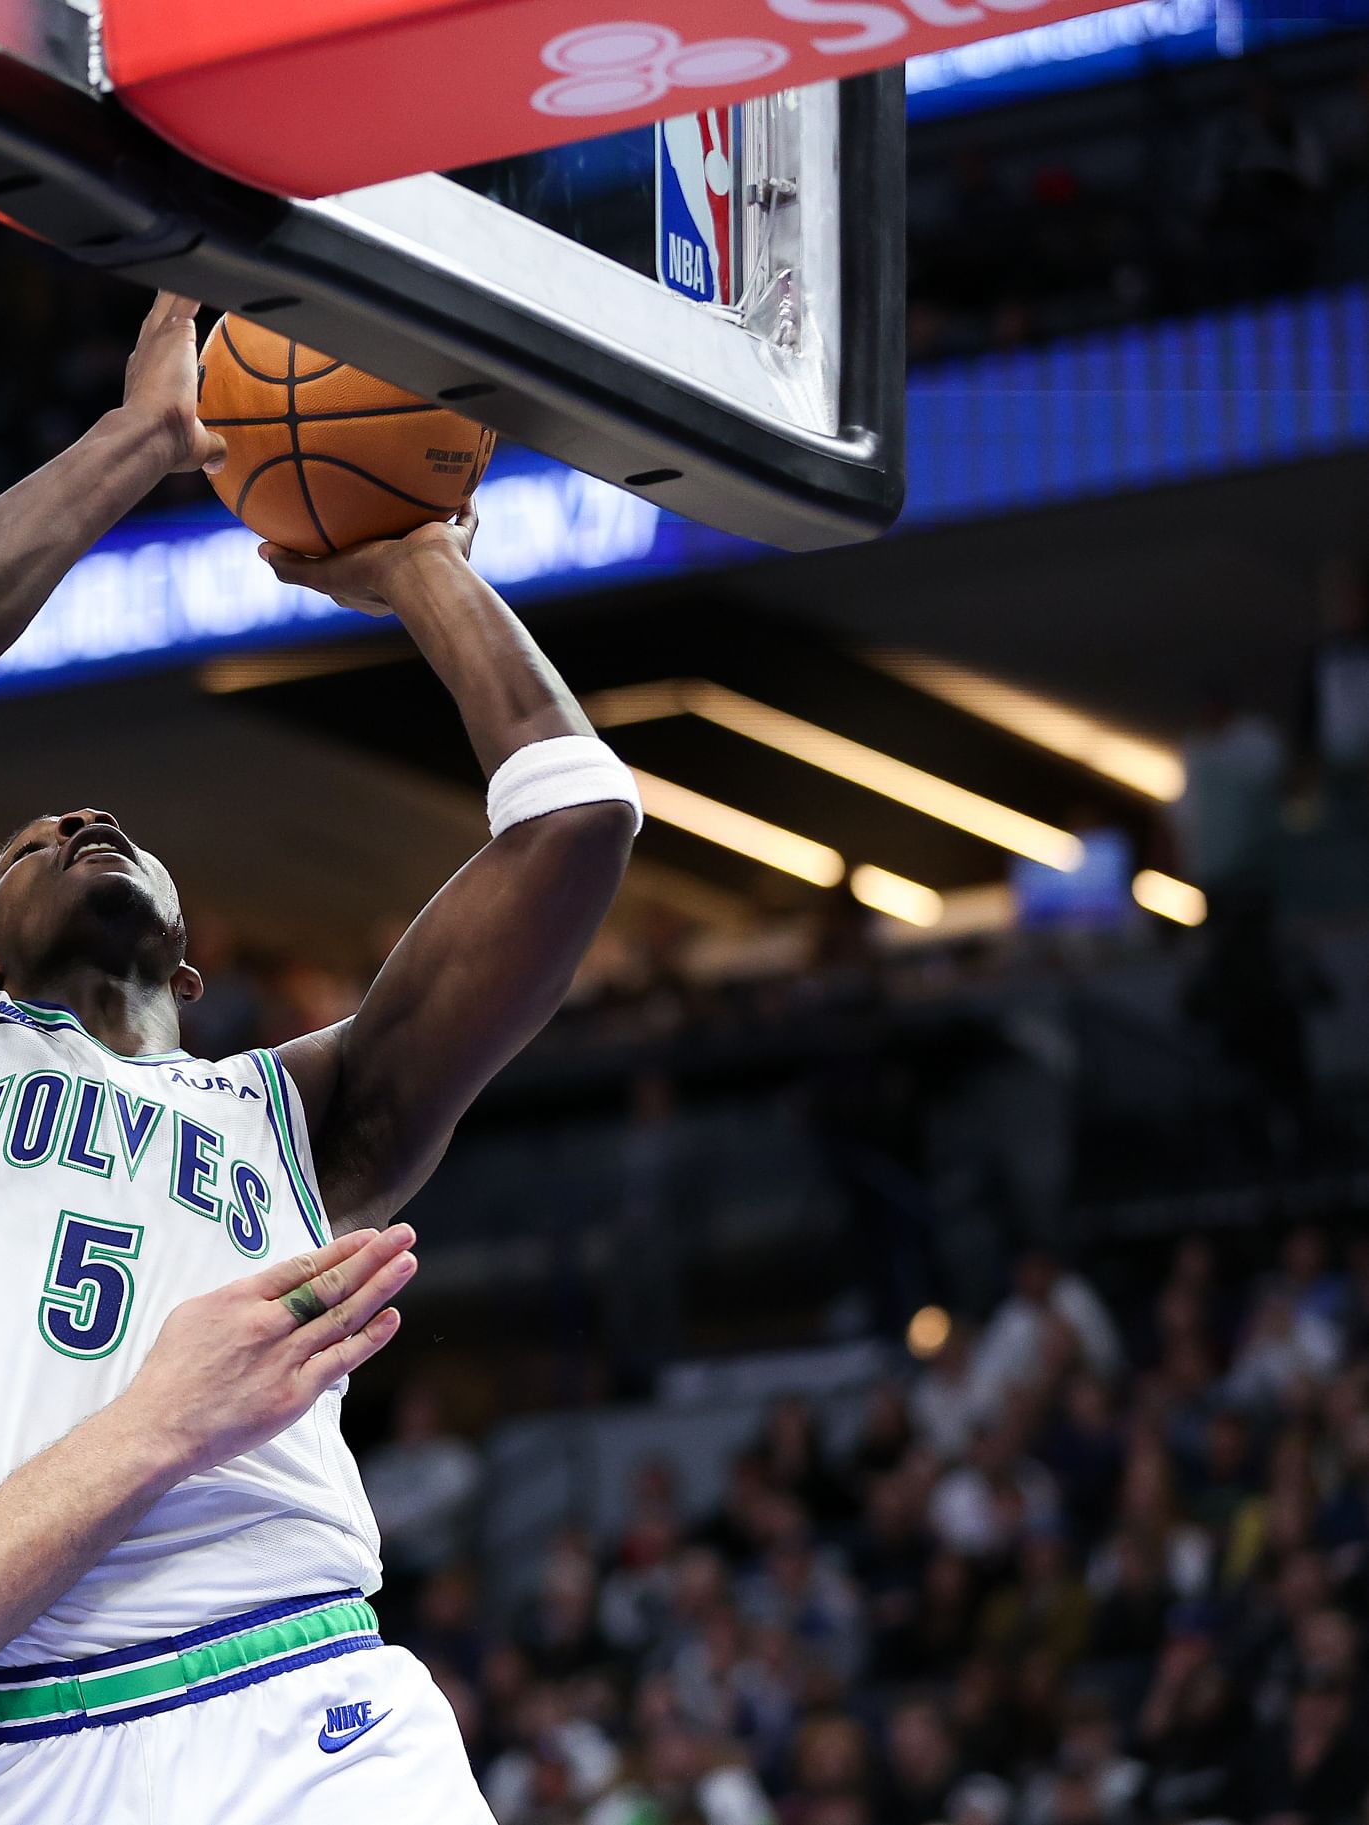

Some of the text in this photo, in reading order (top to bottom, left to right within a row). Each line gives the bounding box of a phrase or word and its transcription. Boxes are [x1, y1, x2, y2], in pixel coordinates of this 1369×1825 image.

[668, 231, 705, 295] NBA
[38, 1209, 144, 1360] 5
[325, 1700, 372, 1733] NIKE
